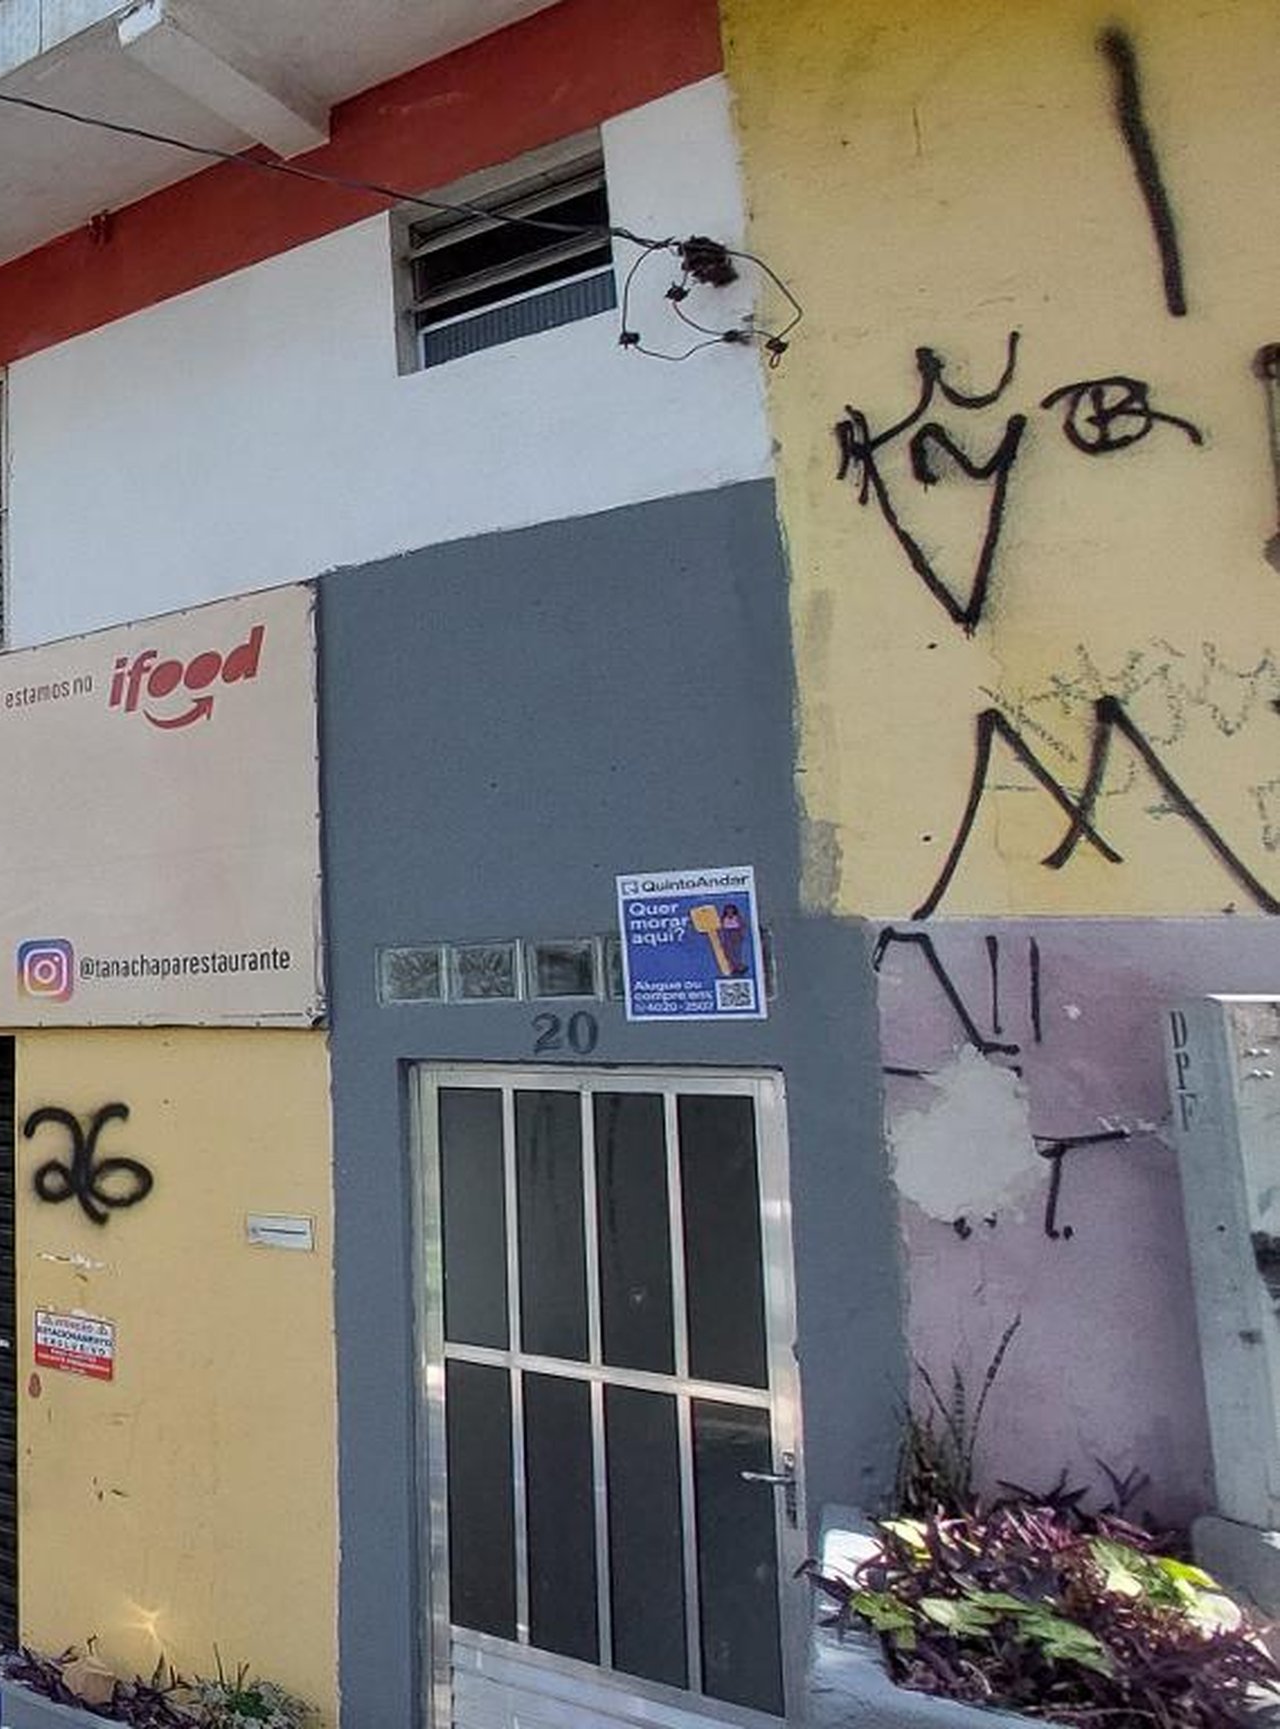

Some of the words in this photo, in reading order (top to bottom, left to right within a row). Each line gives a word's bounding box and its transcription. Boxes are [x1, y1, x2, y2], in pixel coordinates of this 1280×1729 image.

[109, 625, 265, 712] ifood
[5, 680, 70, 708] estamos
[74, 676, 93, 694] no
[641, 874, 750, 894] QuintoAndar
[629, 901, 680, 917] Quer
[630, 917, 689, 930] morar
[631, 927, 686, 946] aqui?
[79, 947, 291, 980] @tanachaparestaurante
[530, 1011, 600, 1056] 20
